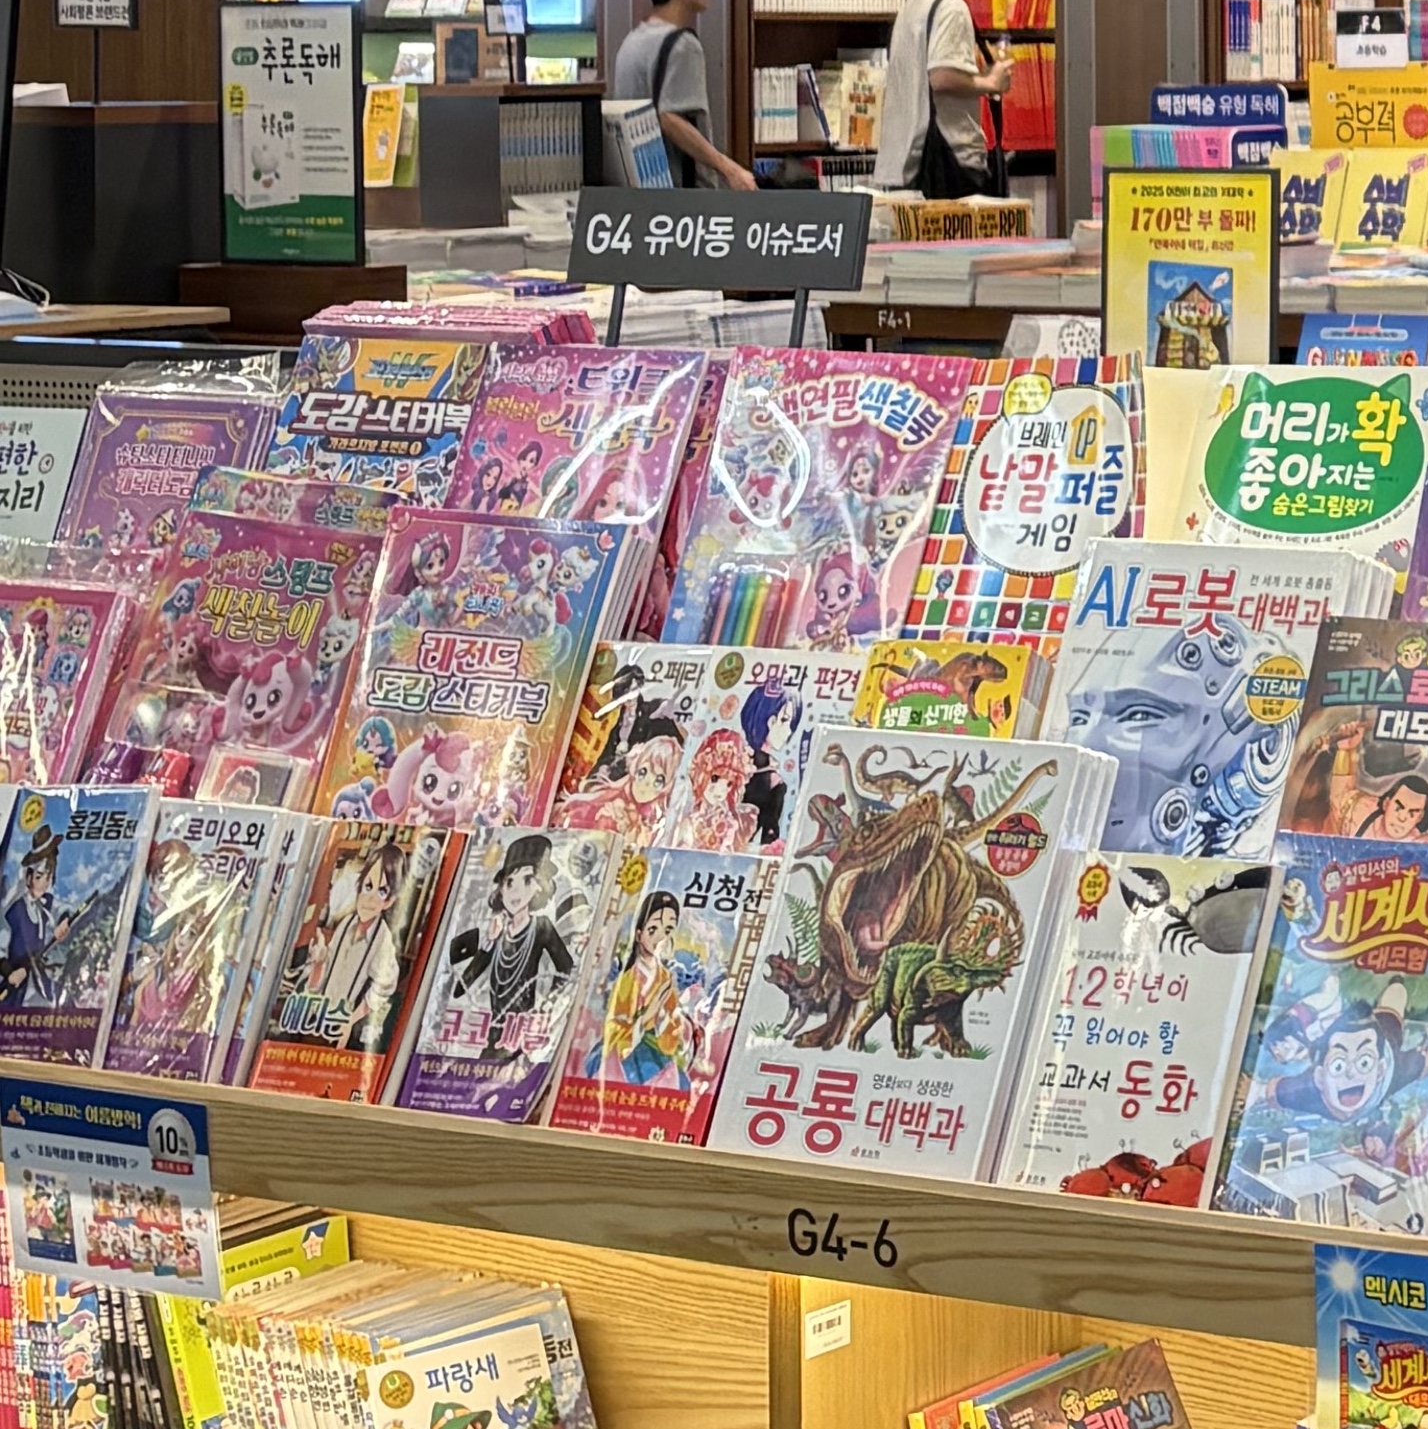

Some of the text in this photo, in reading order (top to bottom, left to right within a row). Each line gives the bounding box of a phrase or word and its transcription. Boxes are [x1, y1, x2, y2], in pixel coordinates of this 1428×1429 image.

[261, 36, 341, 85] 추론독해
[1218, 93, 1248, 117] 유형
[1335, 99, 1396, 145] 공부력
[585, 212, 844, 259] G4 유아동 이슈도서
[1130, 206, 1257, 233] 170만 부 돌파!
[876, 309, 911, 331] F4-1
[299, 391, 473, 439] 도감 스티커북
[750, 375, 861, 427] 색연필
[857, 378, 947, 449] 색칠북
[1240, 390, 1408, 468] 머리가 확
[1020, 419, 1068, 449] 브레인
[978, 443, 1125, 516] 낱말 퍼즐
[1238, 446, 1377, 513] 좋아지는
[1015, 512, 1078, 553] 게임
[200, 583, 326, 651] 색칠놀이
[1237, 593, 1332, 636] 대백과
[419, 633, 522, 679] 레전드
[645, 658, 705, 693] 오페라
[369, 671, 549, 722] 도감 스티커북
[745, 661, 809, 698] 오만과
[814, 666, 861, 703] 편견
[1250, 678, 1302, 697] STEAM
[1321, 667, 1405, 706] 그리스
[65, 810, 139, 841] 홍길동전
[183, 817, 266, 850] 로미오와
[682, 871, 764, 915] 심청전
[1366, 945, 1428, 973] 대모험
[280, 993, 352, 1041] 에디슨
[436, 1007, 552, 1054] 코코 샤넬
[1051, 1013, 1180, 1056] 꼭 읽어야 할
[744, 1061, 966, 1155] 공룡 대백과
[916, 1079, 955, 1099] 생생한
[1038, 1059, 1199, 1122] 교과서 동화
[786, 1207, 899, 1269] G4-6
[1362, 1274, 1428, 1311] 멕시코
[424, 1352, 500, 1395] 파랑새
